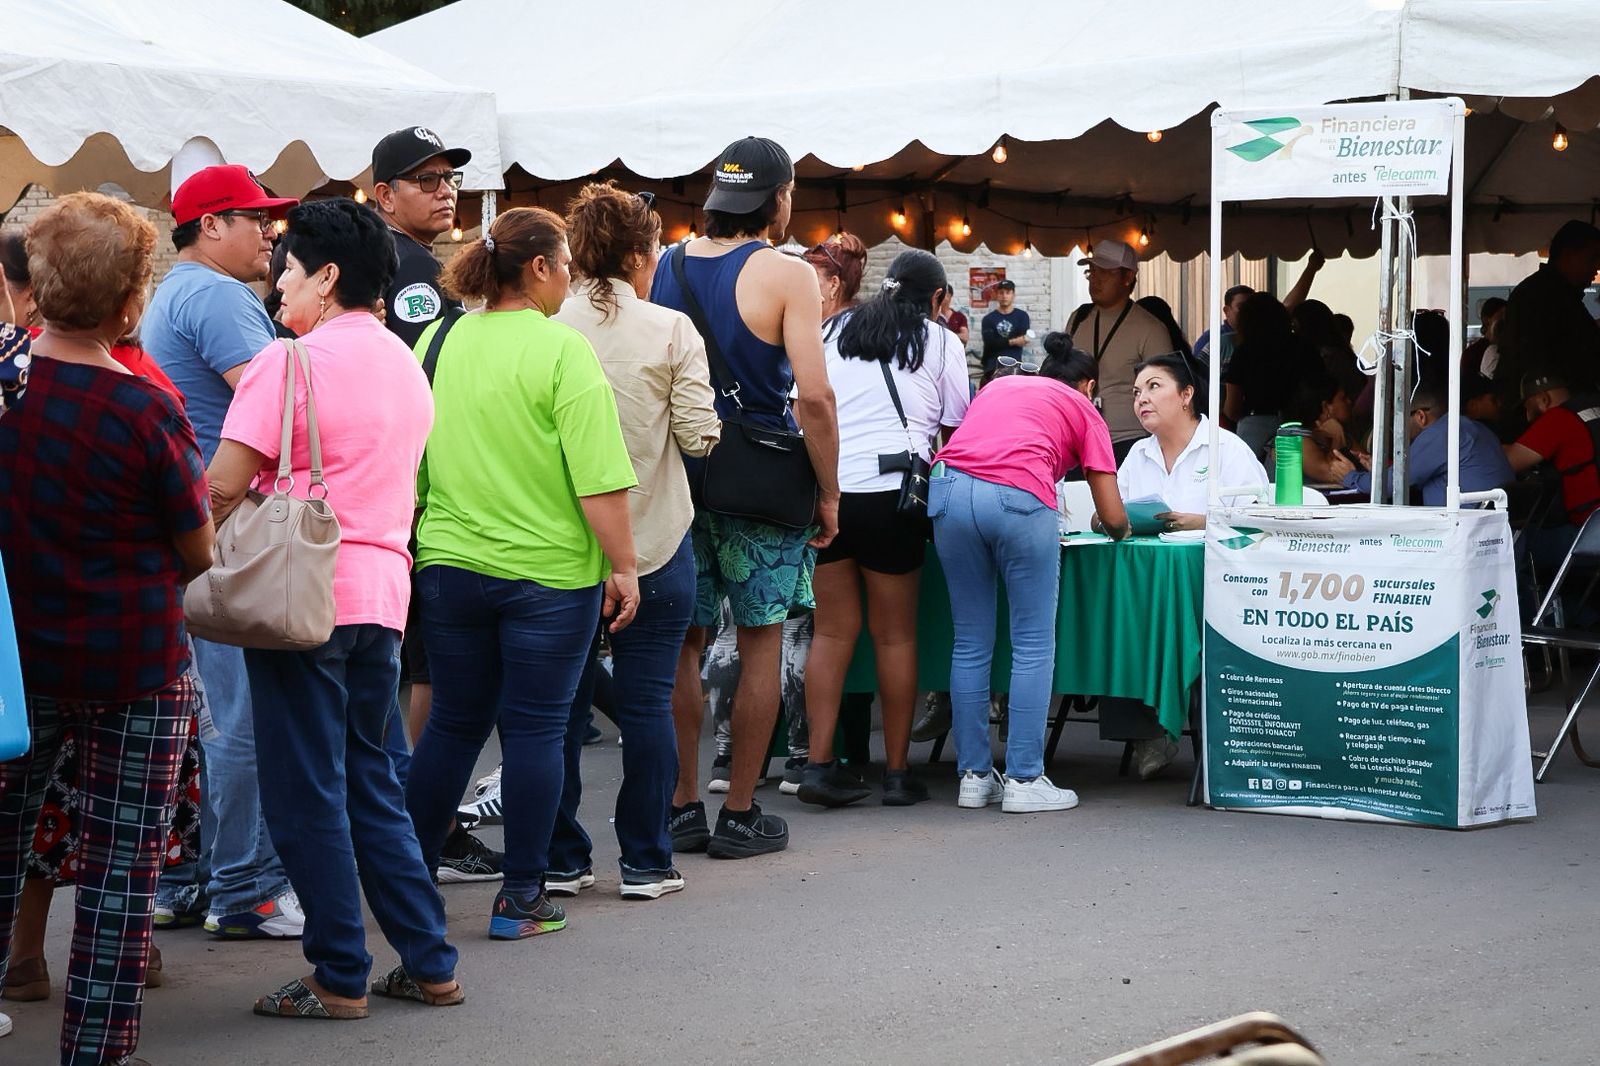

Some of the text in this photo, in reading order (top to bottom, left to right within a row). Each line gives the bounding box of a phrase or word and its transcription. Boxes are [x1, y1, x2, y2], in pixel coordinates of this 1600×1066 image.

[1321, 115, 1416, 133] Financiera
[1336, 135, 1442, 157] Bienestar
[1332, 165, 1437, 183] antes Telecomm
[1276, 530, 1335, 540] Financiera
[1288, 539, 1350, 554] Bienestar
[1359, 537, 1383, 547] antes
[1223, 573, 1268, 584] Contamos
[1251, 571, 1365, 604] con 1,700
[1373, 579, 1435, 591] sucursales
[1373, 592, 1432, 606] FINABIEN
[1243, 608, 1413, 633] EN TODO EL PAÍS
[1262, 635, 1392, 650] Localiza la más cercana en
[1276, 650, 1376, 663] www.gob.mx/finabien
[1226, 674, 1244, 682] Cobro
[1254, 676, 1283, 684] Remesas
[1227, 688, 1279, 698] Giros nacionales
[1343, 681, 1373, 690] Apertura
[1374, 683, 1382, 691] de
[1407, 685, 1425, 693] Cetes
[1426, 686, 1451, 695] Directo
[1233, 697, 1282, 707] internacionales
[1343, 700, 1360, 709] Pago
[1361, 701, 1369, 709] de
[1391, 704, 1409, 712] paga
[1415, 704, 1444, 714] internet
[1229, 710, 1245, 719] Pago
[1254, 711, 1281, 720] créditos
[1265, 720, 1301, 730] INFONAVIT
[1344, 717, 1360, 726] Pago
[1362, 717, 1370, 725] de
[1417, 722, 1430, 730] gas
[1229, 726, 1297, 738] INSTITUTO FONACOT
[1345, 733, 1377, 742] Recargas
[1388, 735, 1412, 744] tiempo
[1413, 737, 1426, 745] aire
[1230, 740, 1304, 751] Operaciones bancarias
[1346, 741, 1384, 751] y telepeaje
[1231, 760, 1260, 768] Adquirir
[1348, 755, 1369, 763] Cobro
[1380, 757, 1406, 765] cachito
[1407, 759, 1433, 768] ganador
[1393, 766, 1422, 775] Nacional
[1375, 776, 1379, 784] y
[1380, 777, 1404, 785] mucho
[1305, 782, 1342, 790] Financiera
[1343, 784, 1358, 792] para
[1367, 787, 1398, 797] Bienestar
[1399, 791, 1421, 800] México
